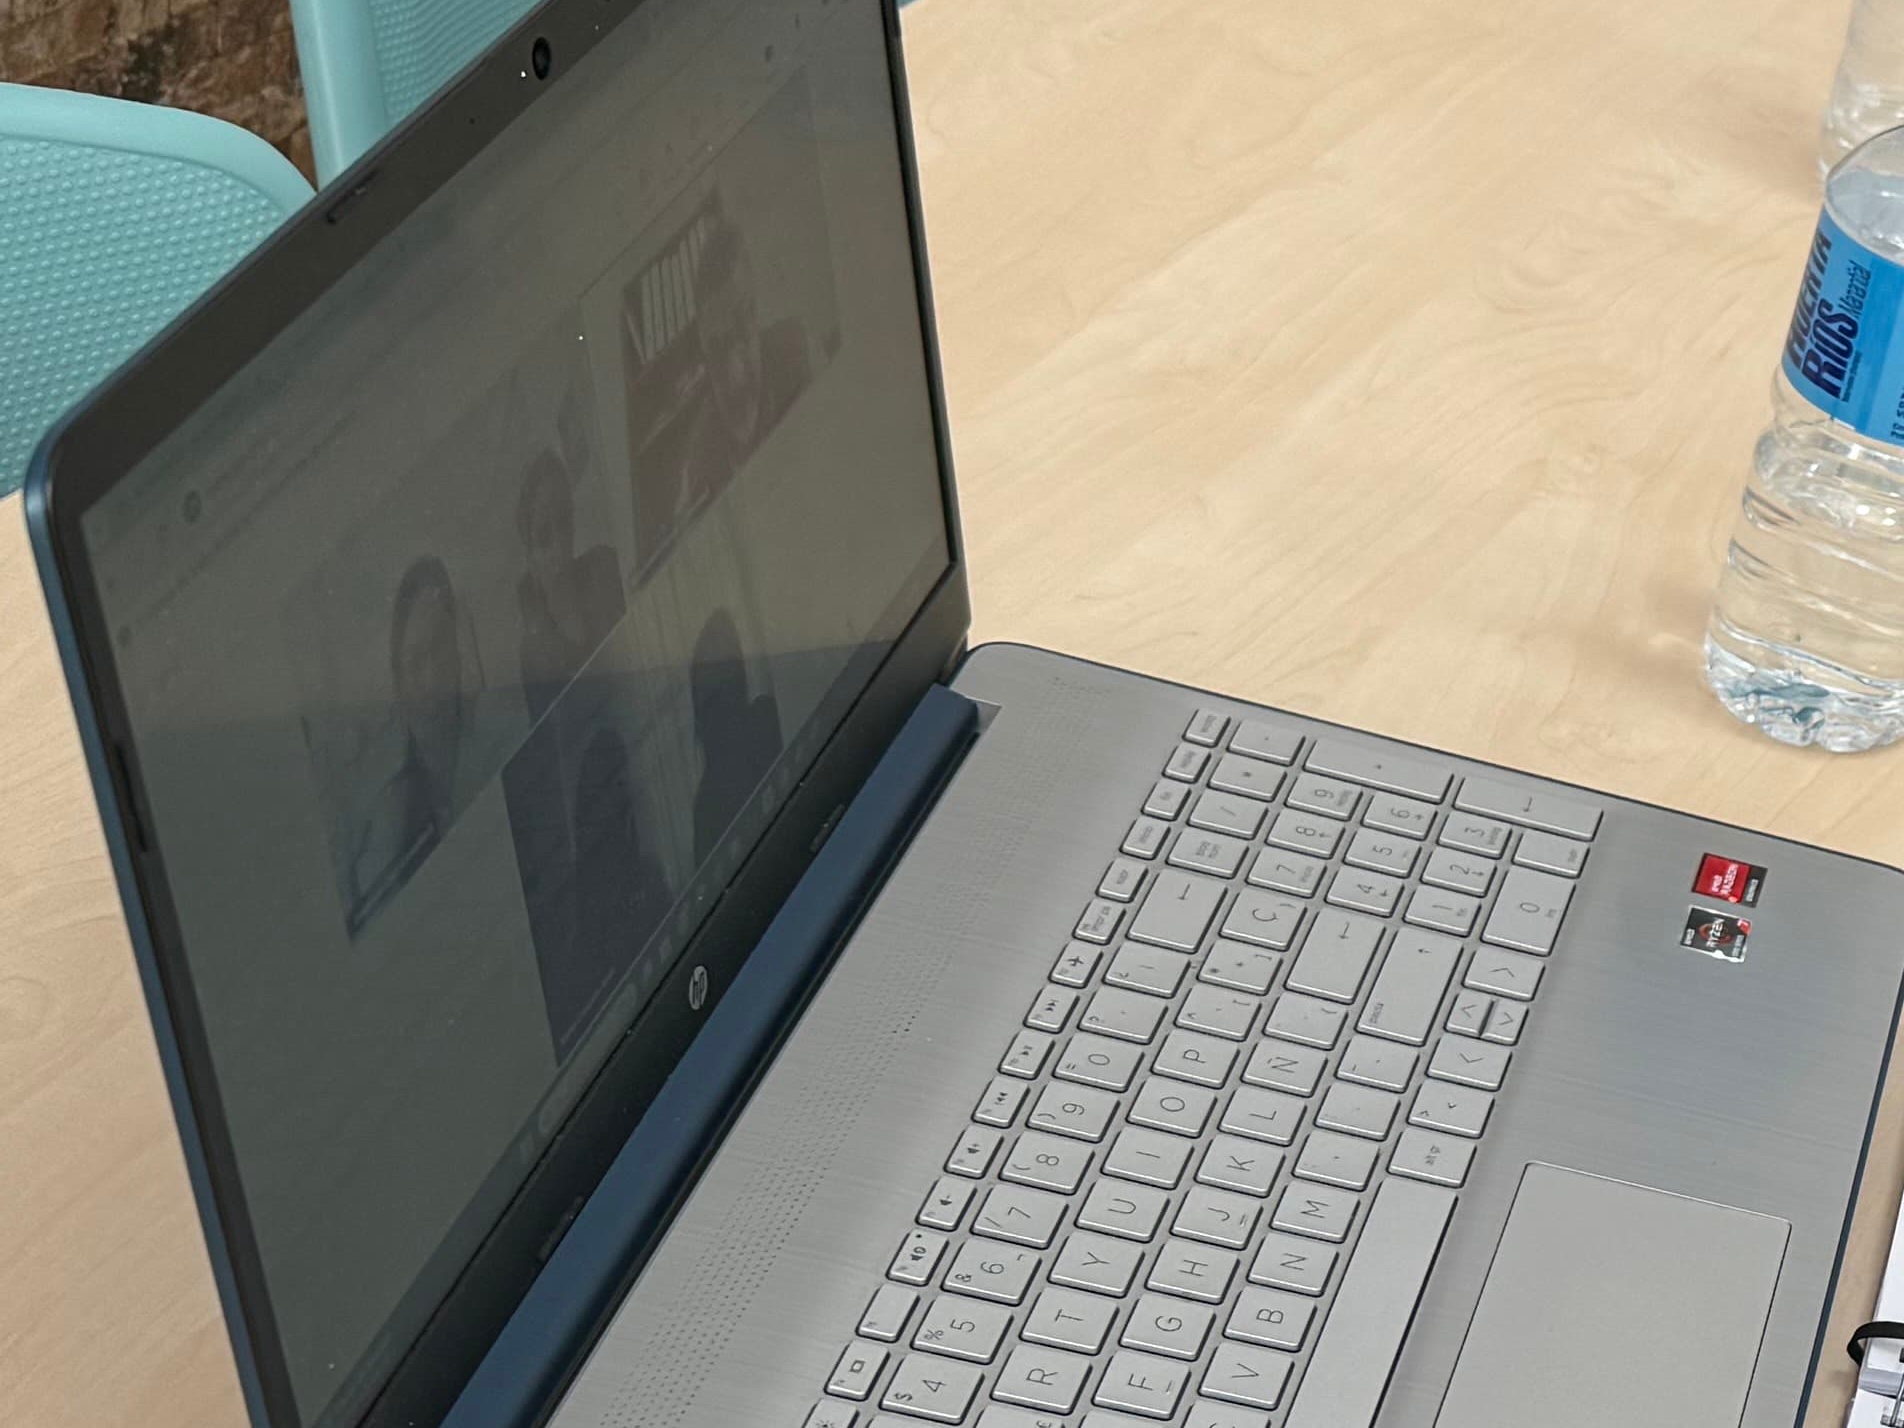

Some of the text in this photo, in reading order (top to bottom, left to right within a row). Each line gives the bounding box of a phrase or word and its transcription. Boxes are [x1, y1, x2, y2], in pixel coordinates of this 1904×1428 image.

[1026, 1369, 1058, 1385] R
[1054, 1309, 1083, 1322] T
[1082, 1252, 1110, 1265] Y
[1108, 1199, 1136, 1214] U
[1160, 1097, 1185, 1112] O
[1182, 1049, 1205, 1063] P
[1128, 1374, 1153, 1391] F
[1155, 1316, 1182, 1332] G
[1179, 1260, 1208, 1276] H
[1208, 1208, 1230, 1222] J
[1227, 1156, 1255, 1172] K
[1249, 1111, 1277, 1120] L
[1267, 1057, 1299, 1073] Ñ
